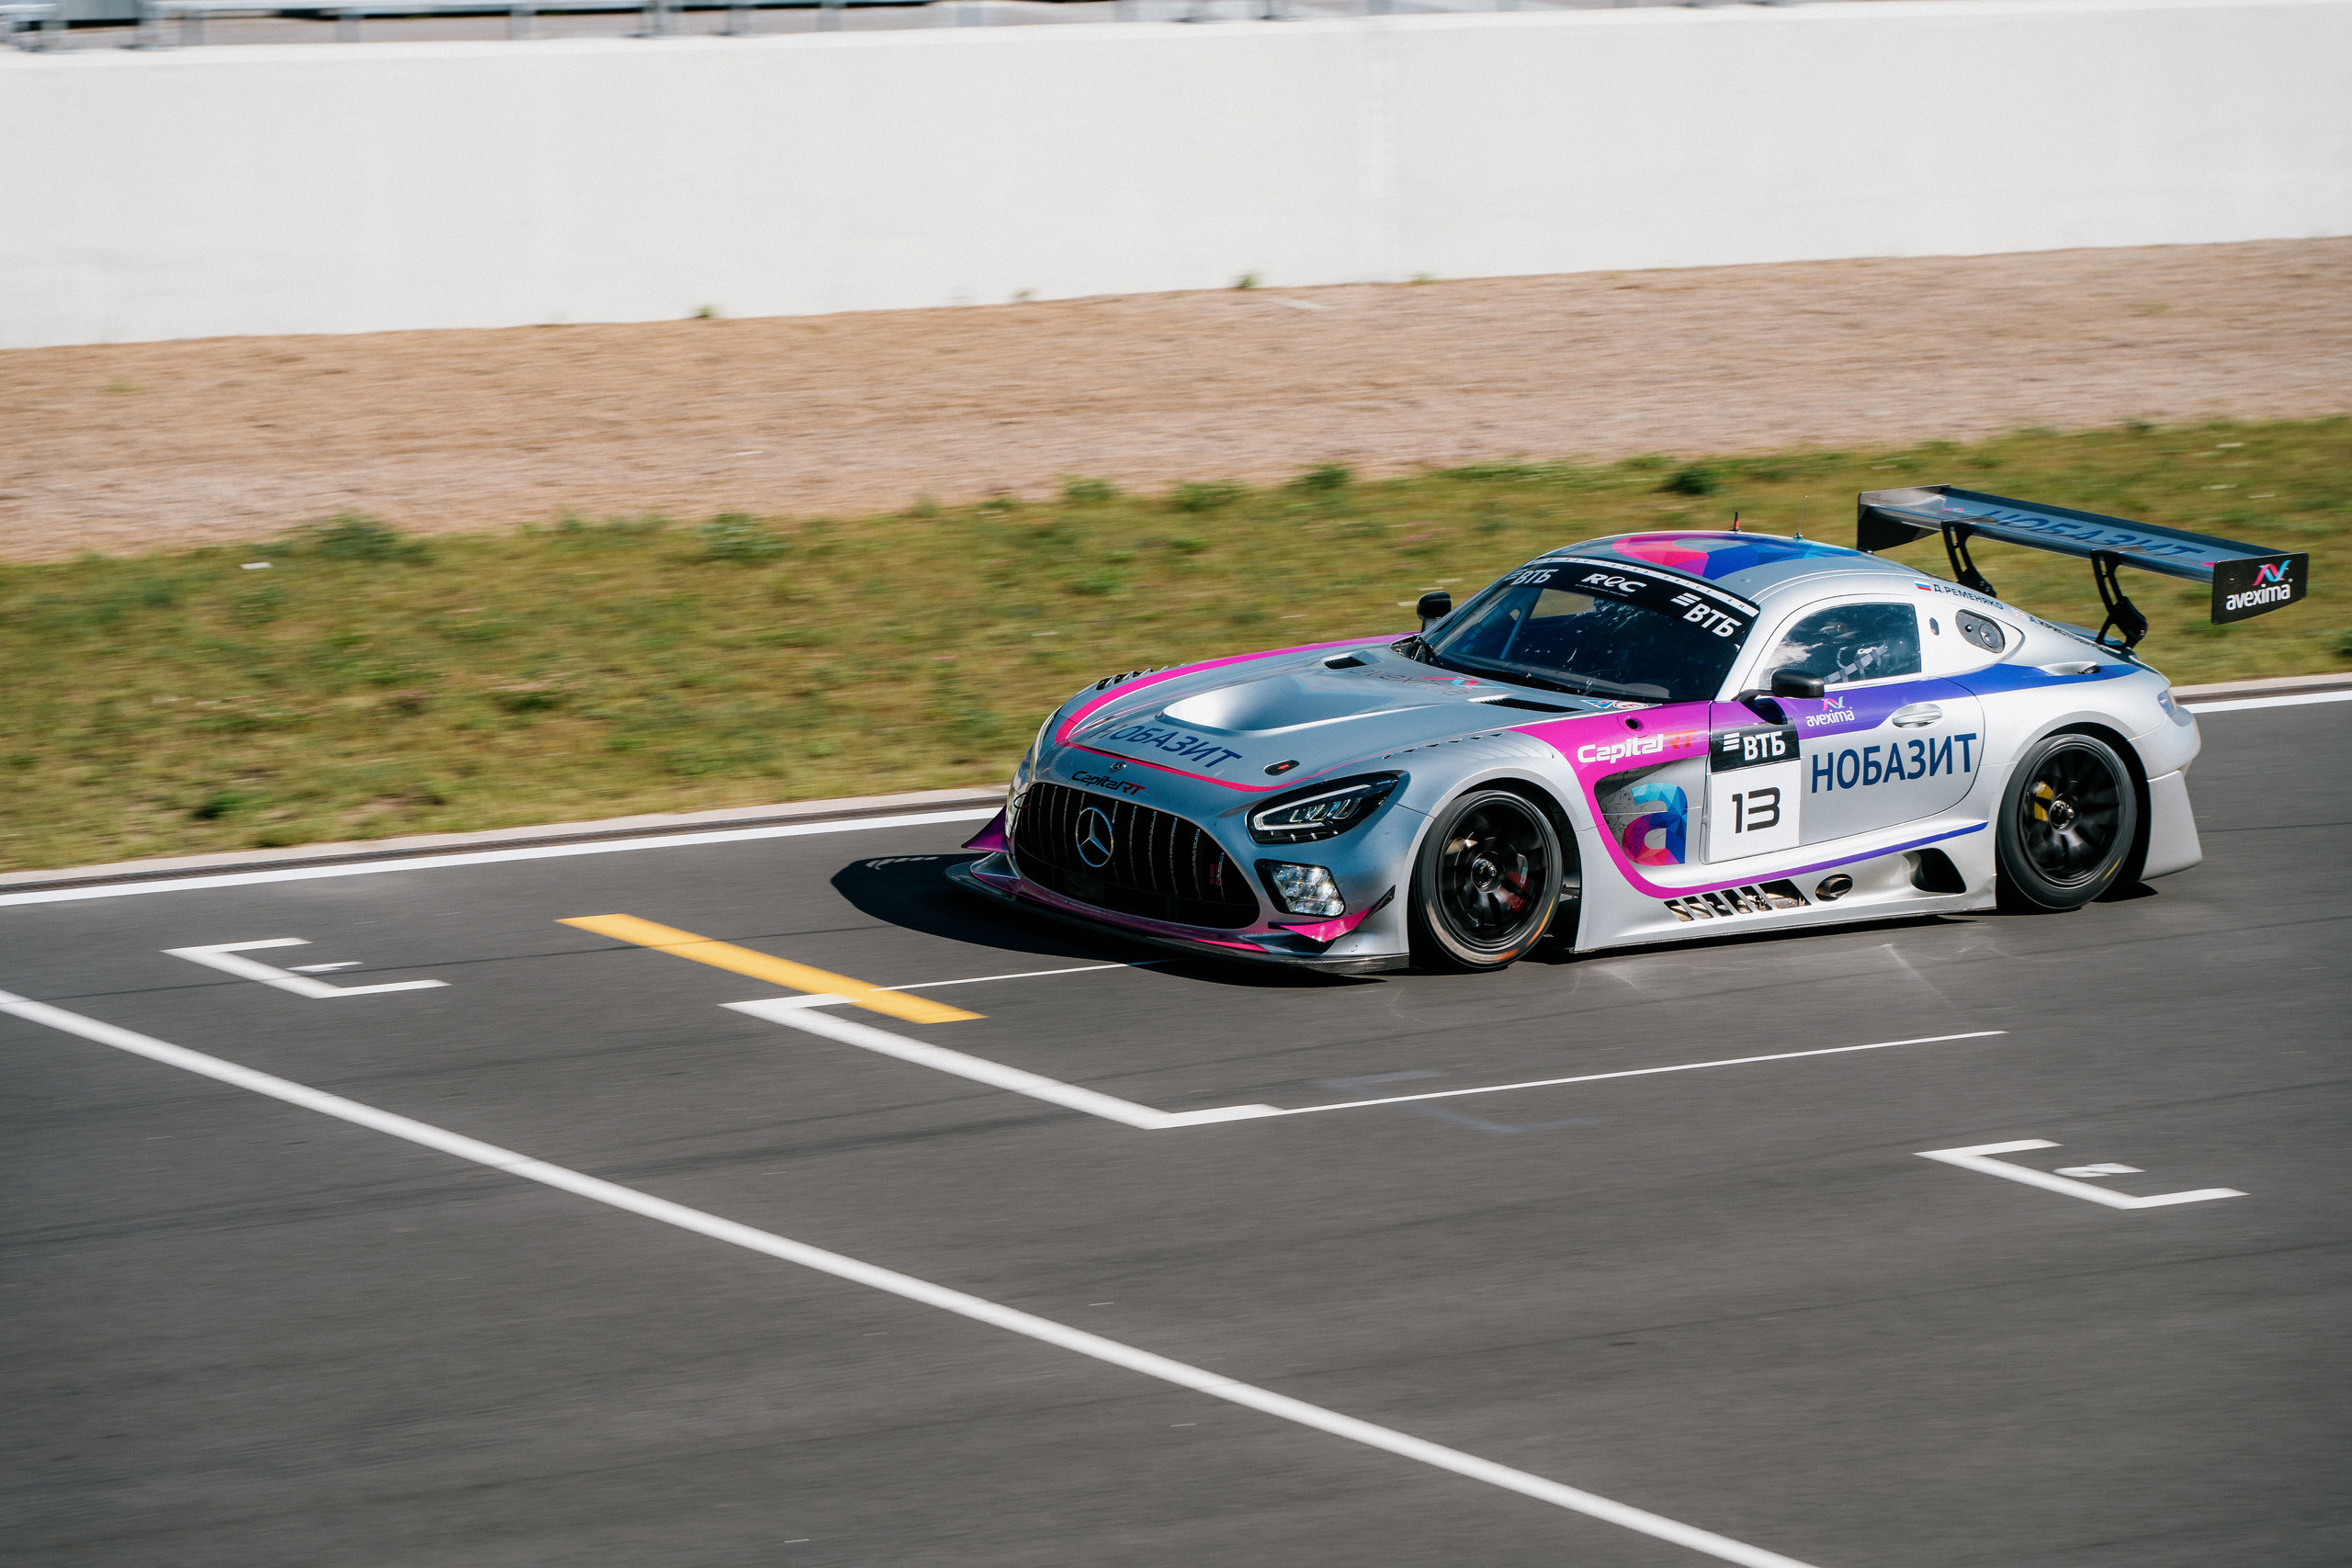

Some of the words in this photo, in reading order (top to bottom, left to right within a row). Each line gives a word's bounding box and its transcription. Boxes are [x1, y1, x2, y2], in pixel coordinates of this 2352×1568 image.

[1510, 569, 1560, 585] ВТБ
[2225, 583, 2291, 611] avexima
[1683, 603, 1743, 637] ВТБ
[1805, 708, 1855, 728] avexima
[1087, 723, 1243, 768] НОБАЗИТ
[1742, 730, 1787, 761] ВТБ
[1811, 732, 1977, 794] НОБАЗИТ
[1732, 786, 1781, 834] 13
